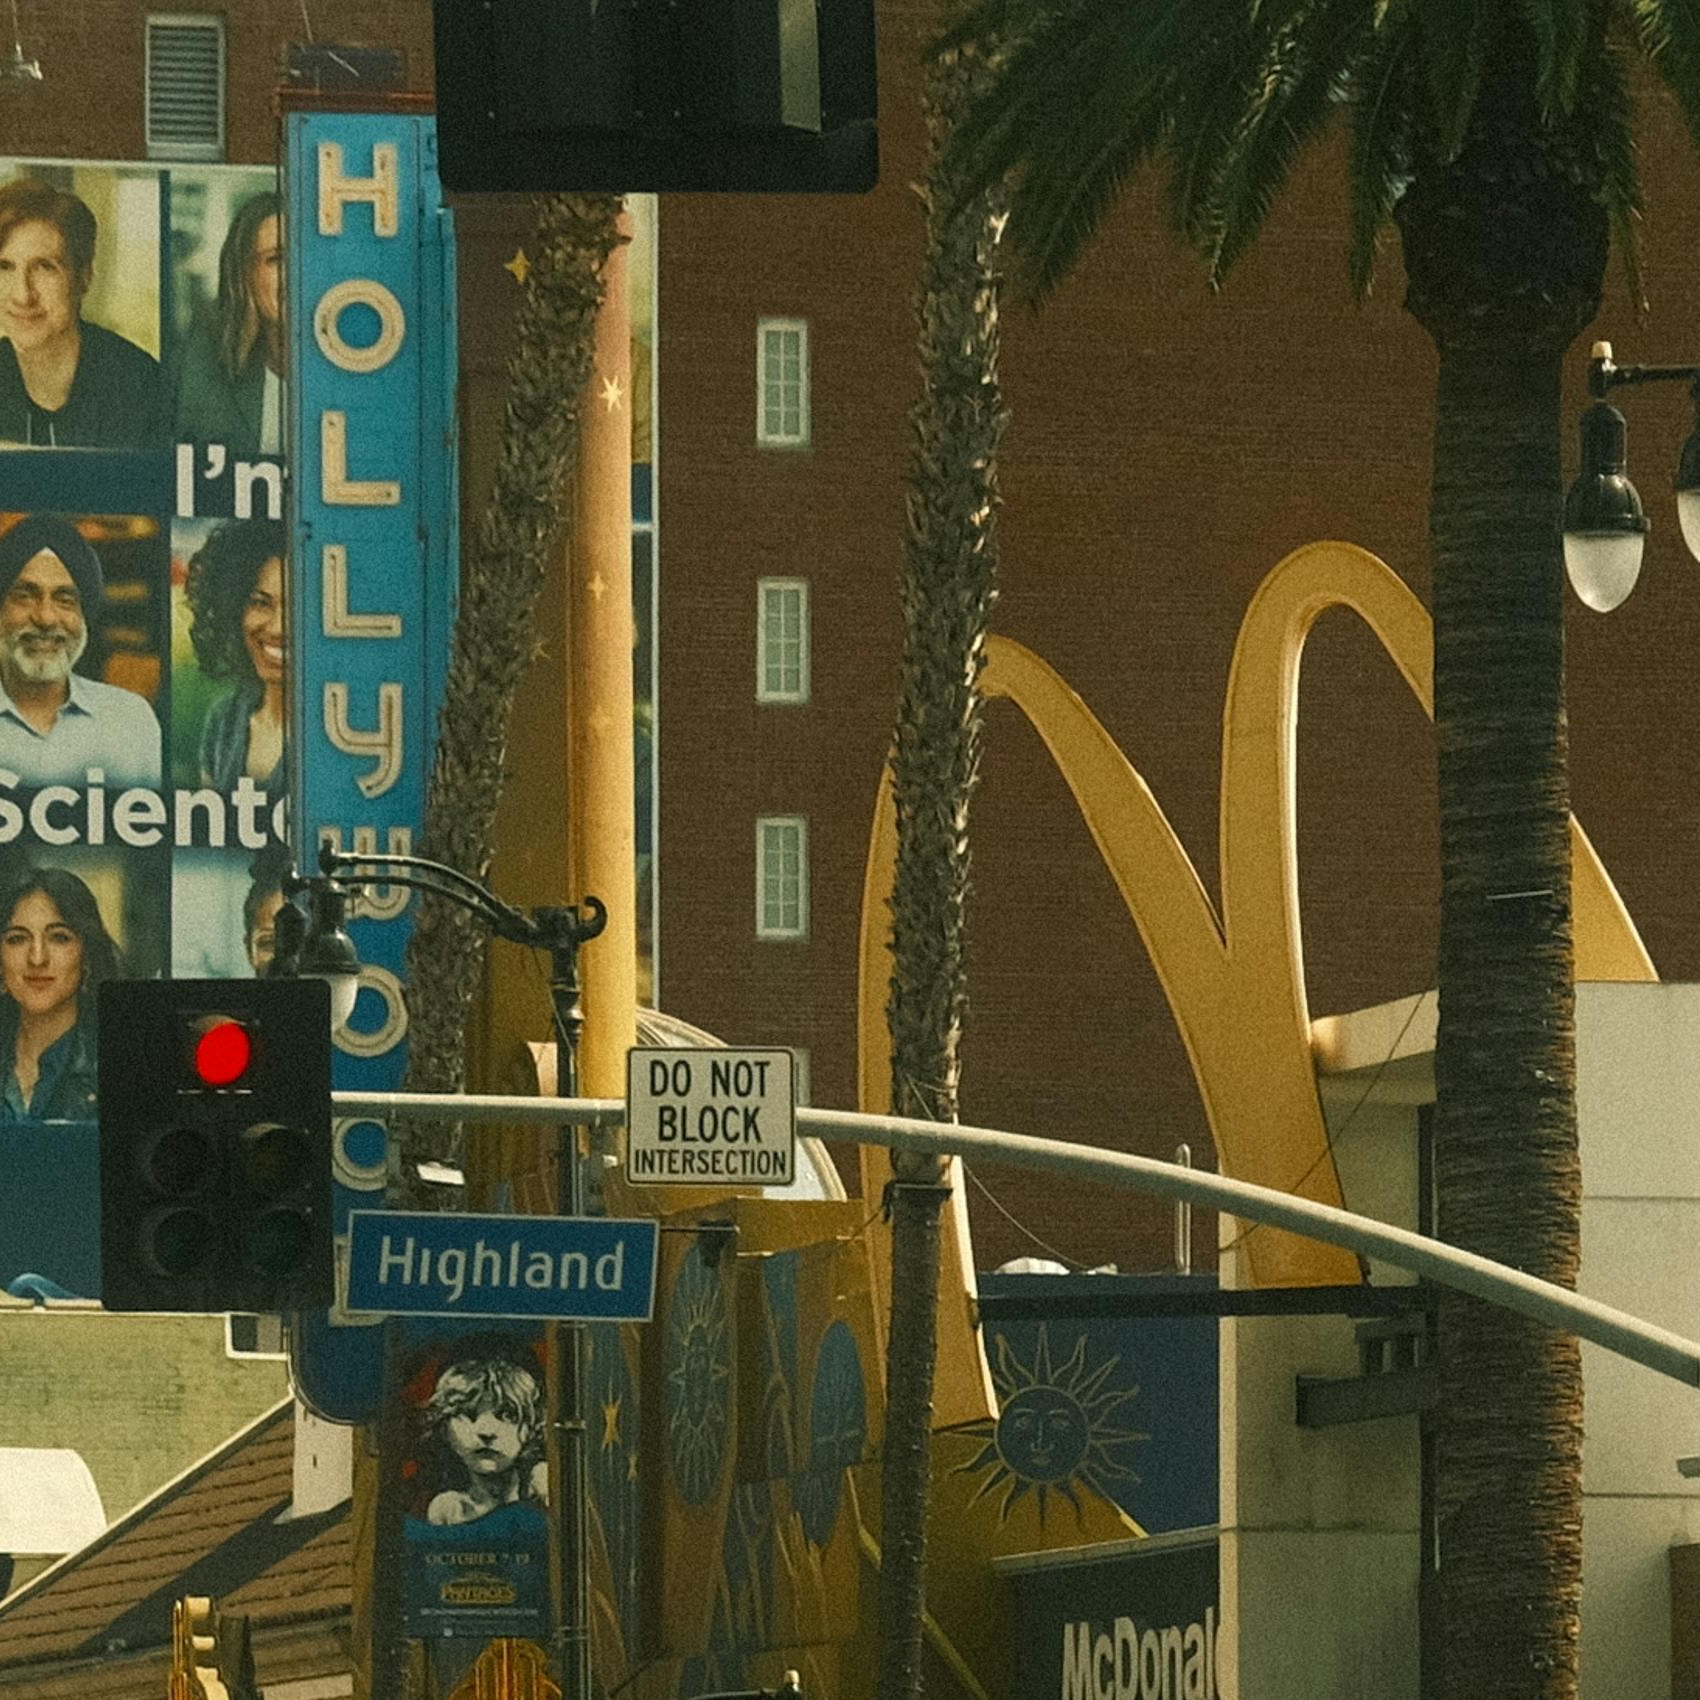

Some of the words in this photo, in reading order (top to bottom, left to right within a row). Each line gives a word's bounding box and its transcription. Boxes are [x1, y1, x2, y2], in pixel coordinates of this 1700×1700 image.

[650, 1059, 692, 1098] DO
[711, 1060, 770, 1098] NOT
[658, 1105, 762, 1144] BLOCK
[635, 1149, 786, 1176] INTERSECTION
[378, 1235, 625, 1303] Highland
[425, 1553, 497, 1566] OCTOBER
